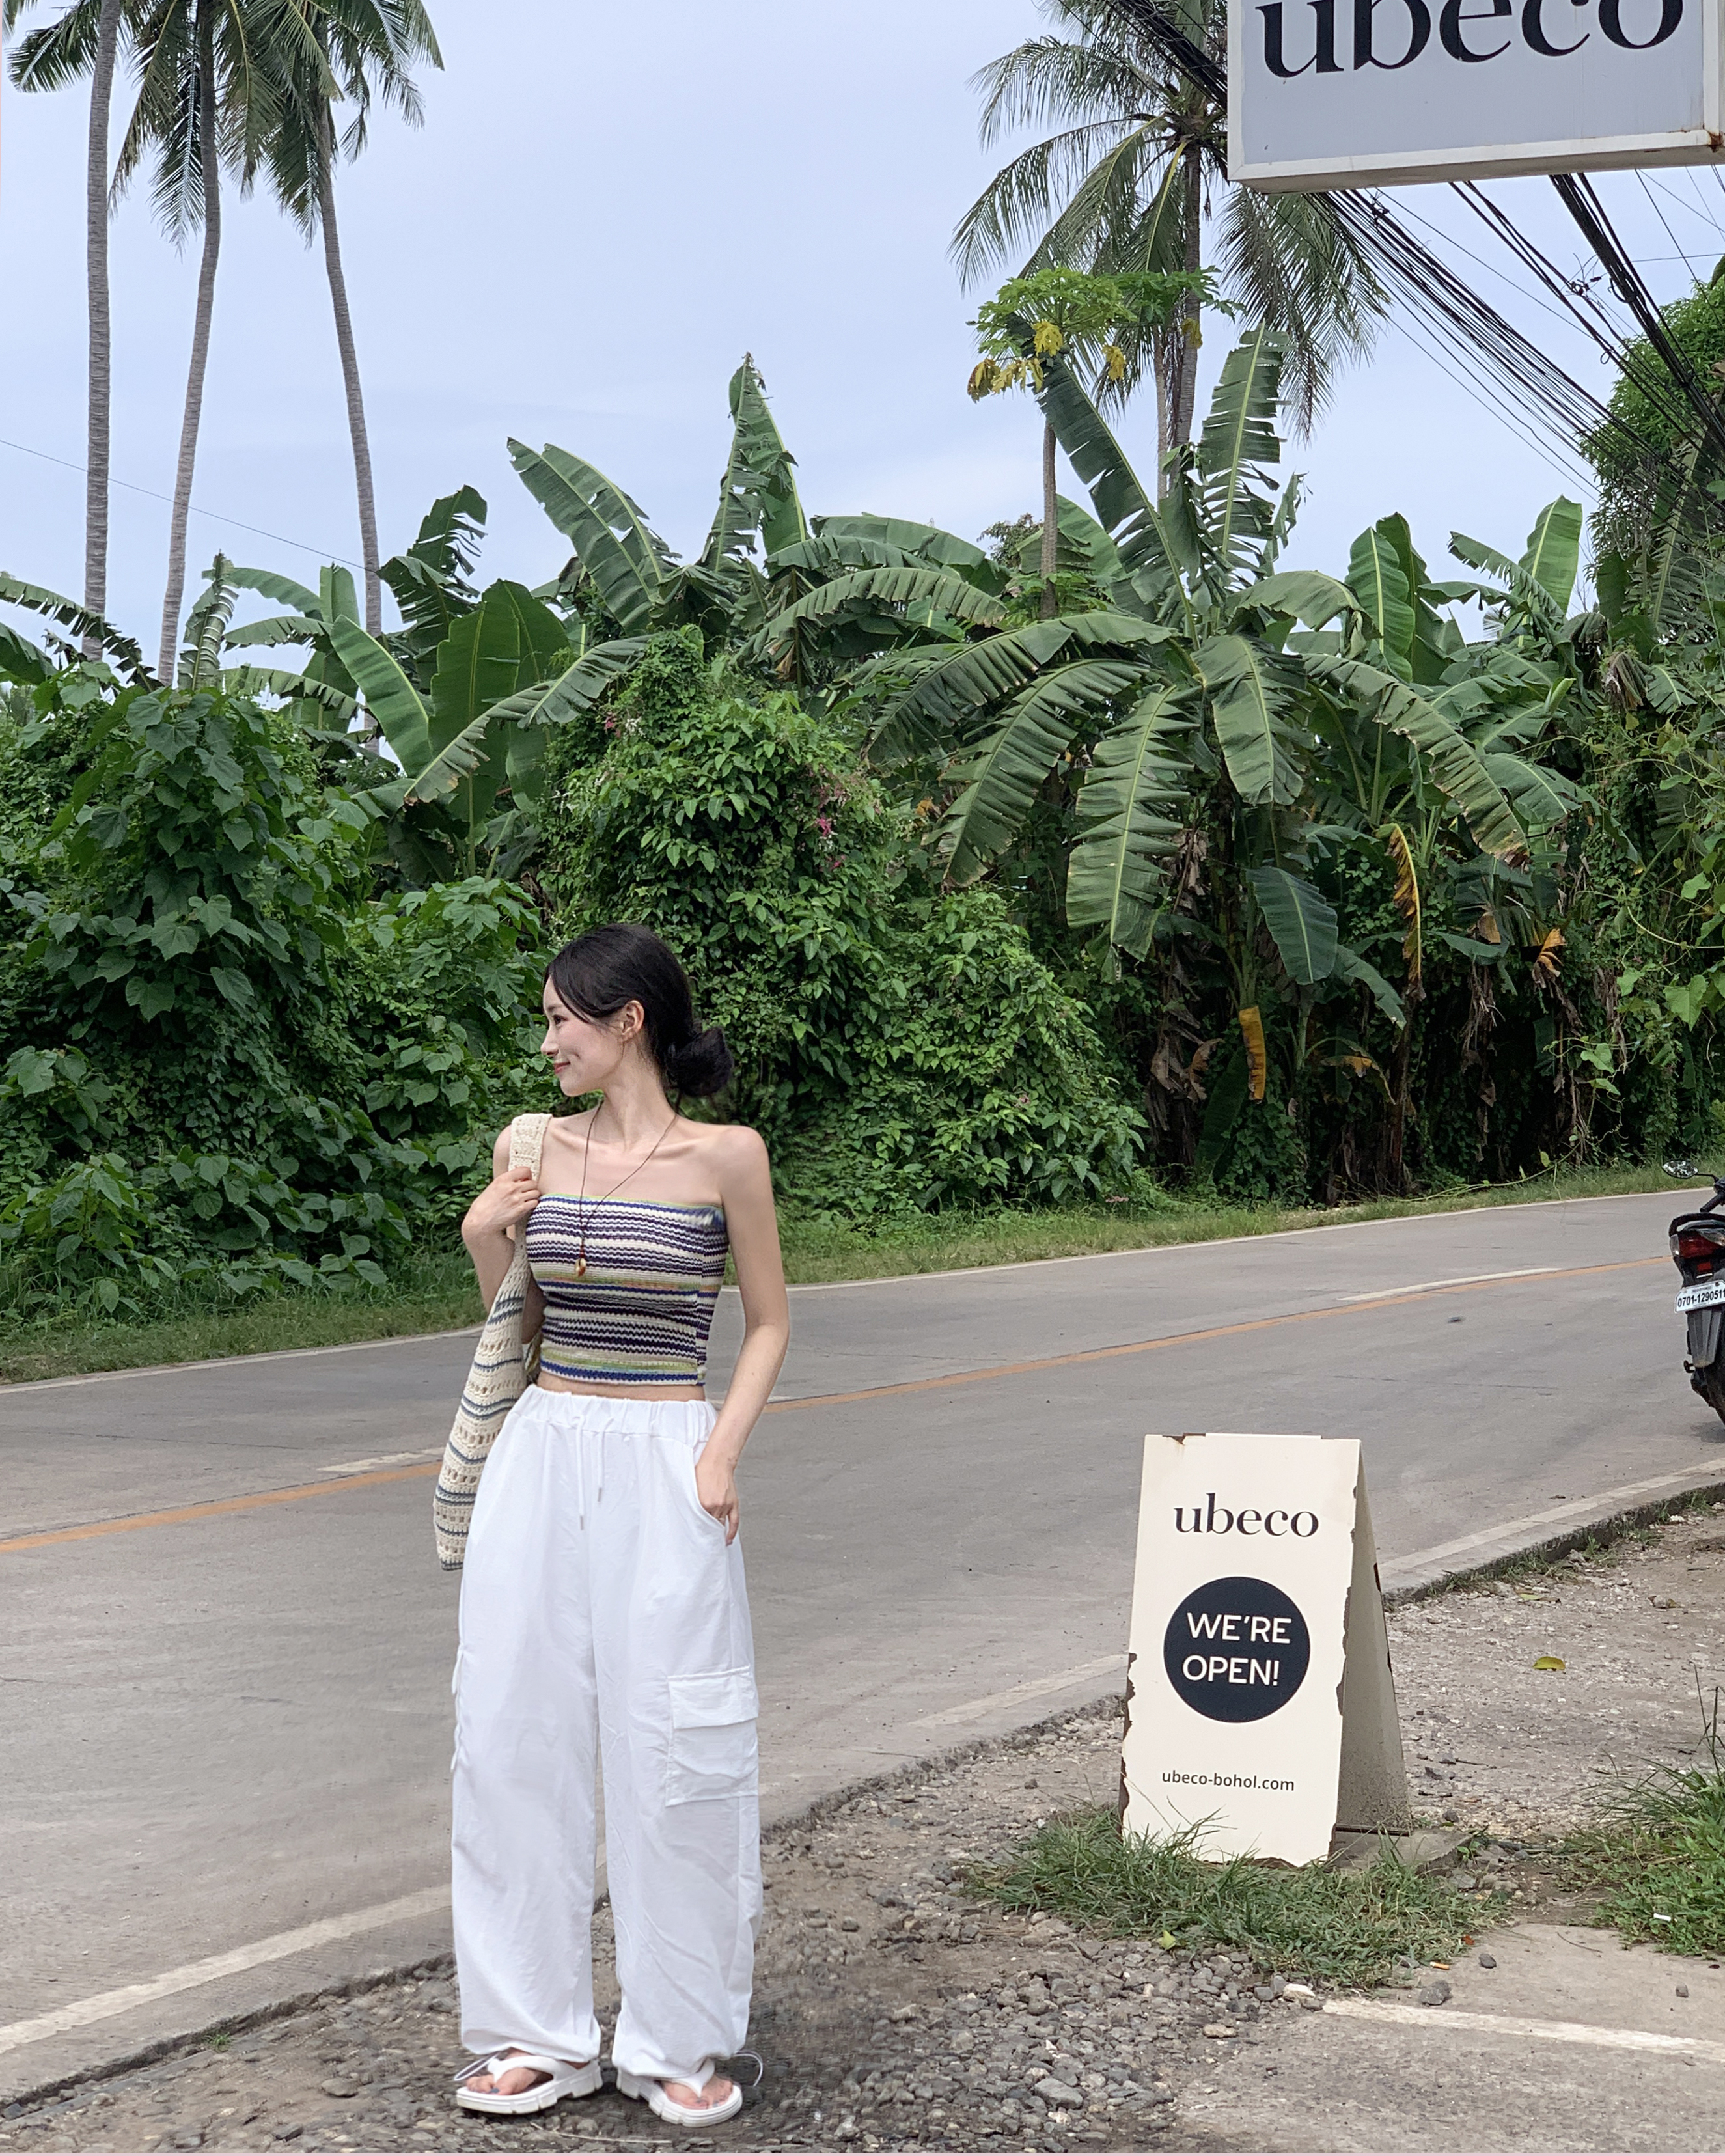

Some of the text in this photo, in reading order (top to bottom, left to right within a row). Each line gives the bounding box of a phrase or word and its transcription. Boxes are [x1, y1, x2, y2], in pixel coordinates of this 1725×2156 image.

[1254, 0, 1683, 78] ubeco
[1174, 1492, 1319, 1538] ubeco
[1187, 1612, 1292, 1644] WE'RE
[1182, 1655, 1280, 1686] OPEN!
[1162, 1769, 1295, 1791] ubeco-bohol.com
